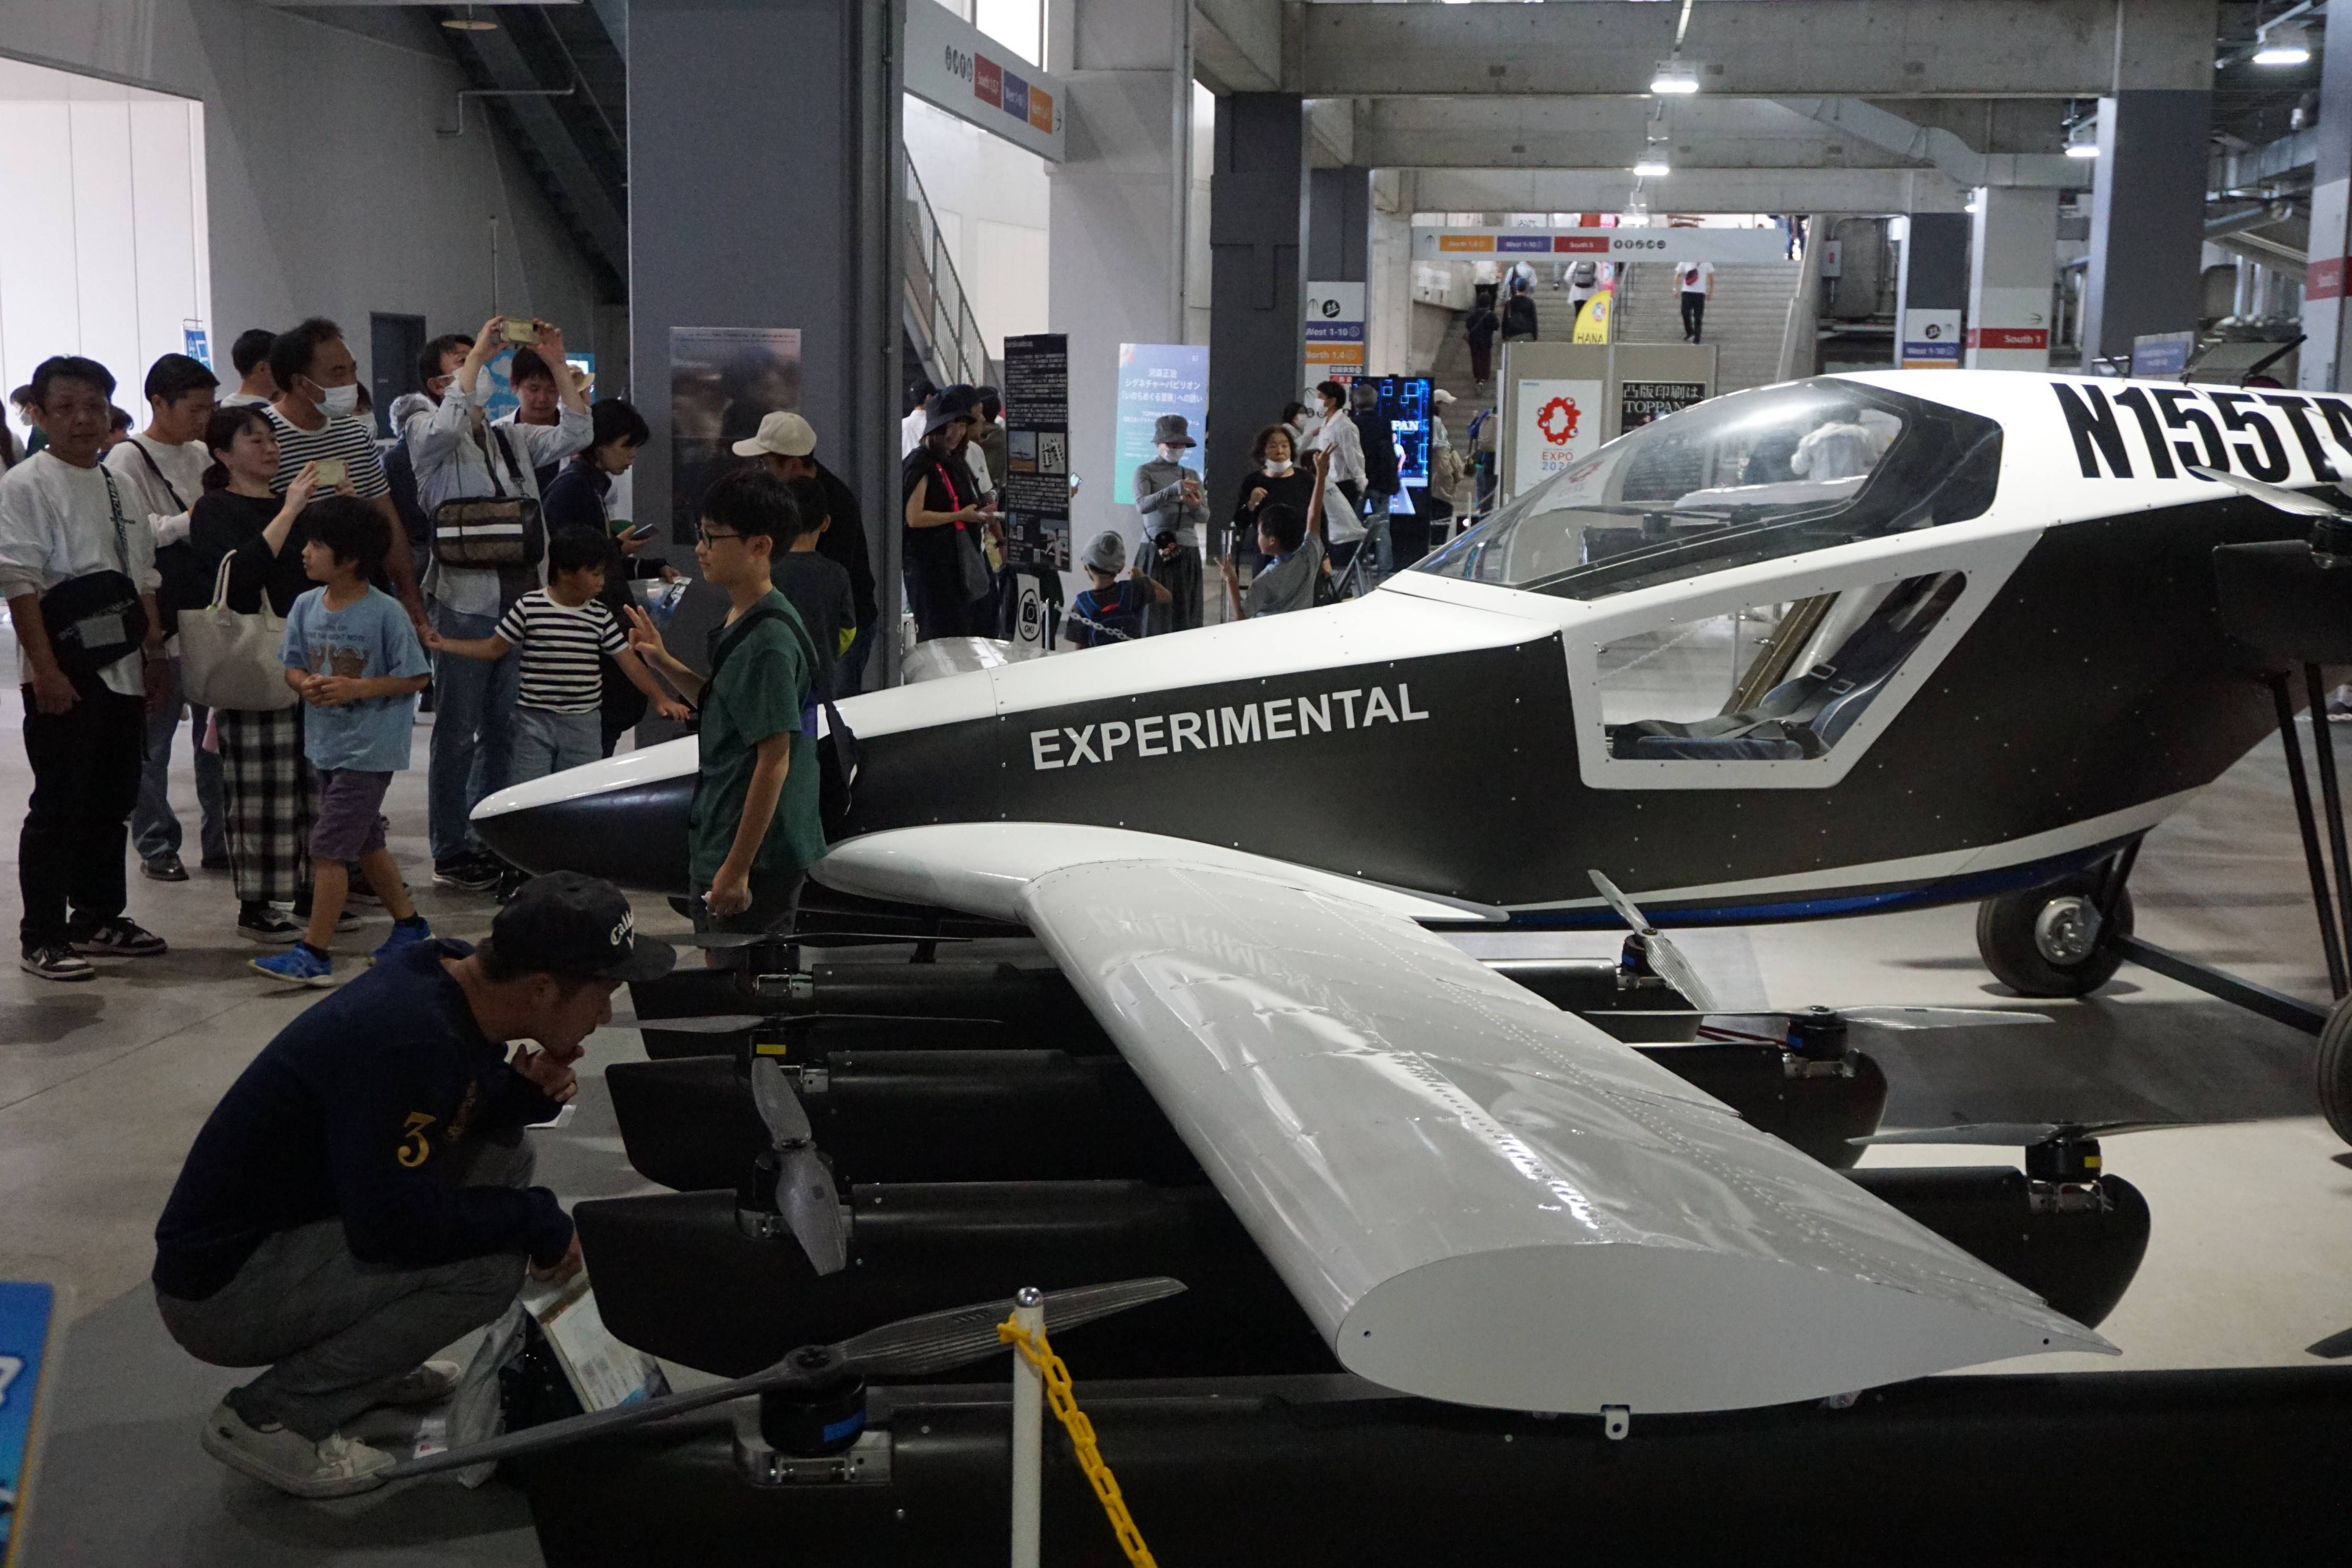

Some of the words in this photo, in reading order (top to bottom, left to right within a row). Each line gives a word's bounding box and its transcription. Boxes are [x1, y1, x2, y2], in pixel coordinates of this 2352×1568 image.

[1307, 328, 1327, 336] West
[1577, 332, 1604, 343] HANA
[2004, 335, 2033, 343] South
[1306, 349, 1330, 358] North
[1542, 452, 1574, 461] EXPO
[1024, 624, 1034, 634] OK!
[1030, 683, 1429, 770] EXPERIMENTAL
[397, 1112, 436, 1168] 3
